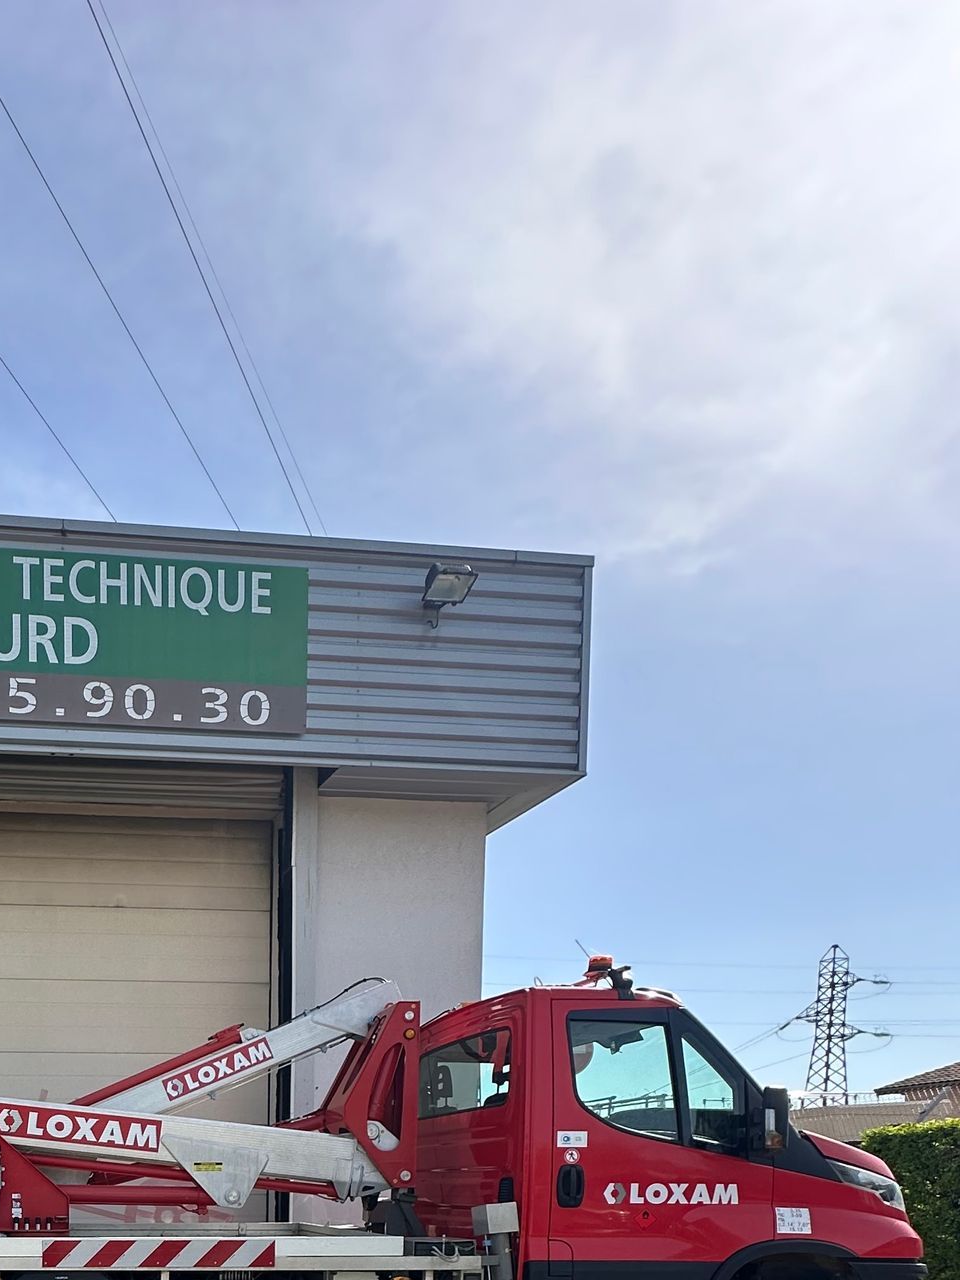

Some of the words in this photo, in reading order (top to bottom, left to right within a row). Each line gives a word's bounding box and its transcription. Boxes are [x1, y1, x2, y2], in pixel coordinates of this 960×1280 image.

[13, 556, 272, 616] TECHNIQUE
[184, 1041, 272, 1090] LOXAM
[26, 1111, 158, 1149] LOXAM
[629, 1183, 739, 1204] LOXAM
